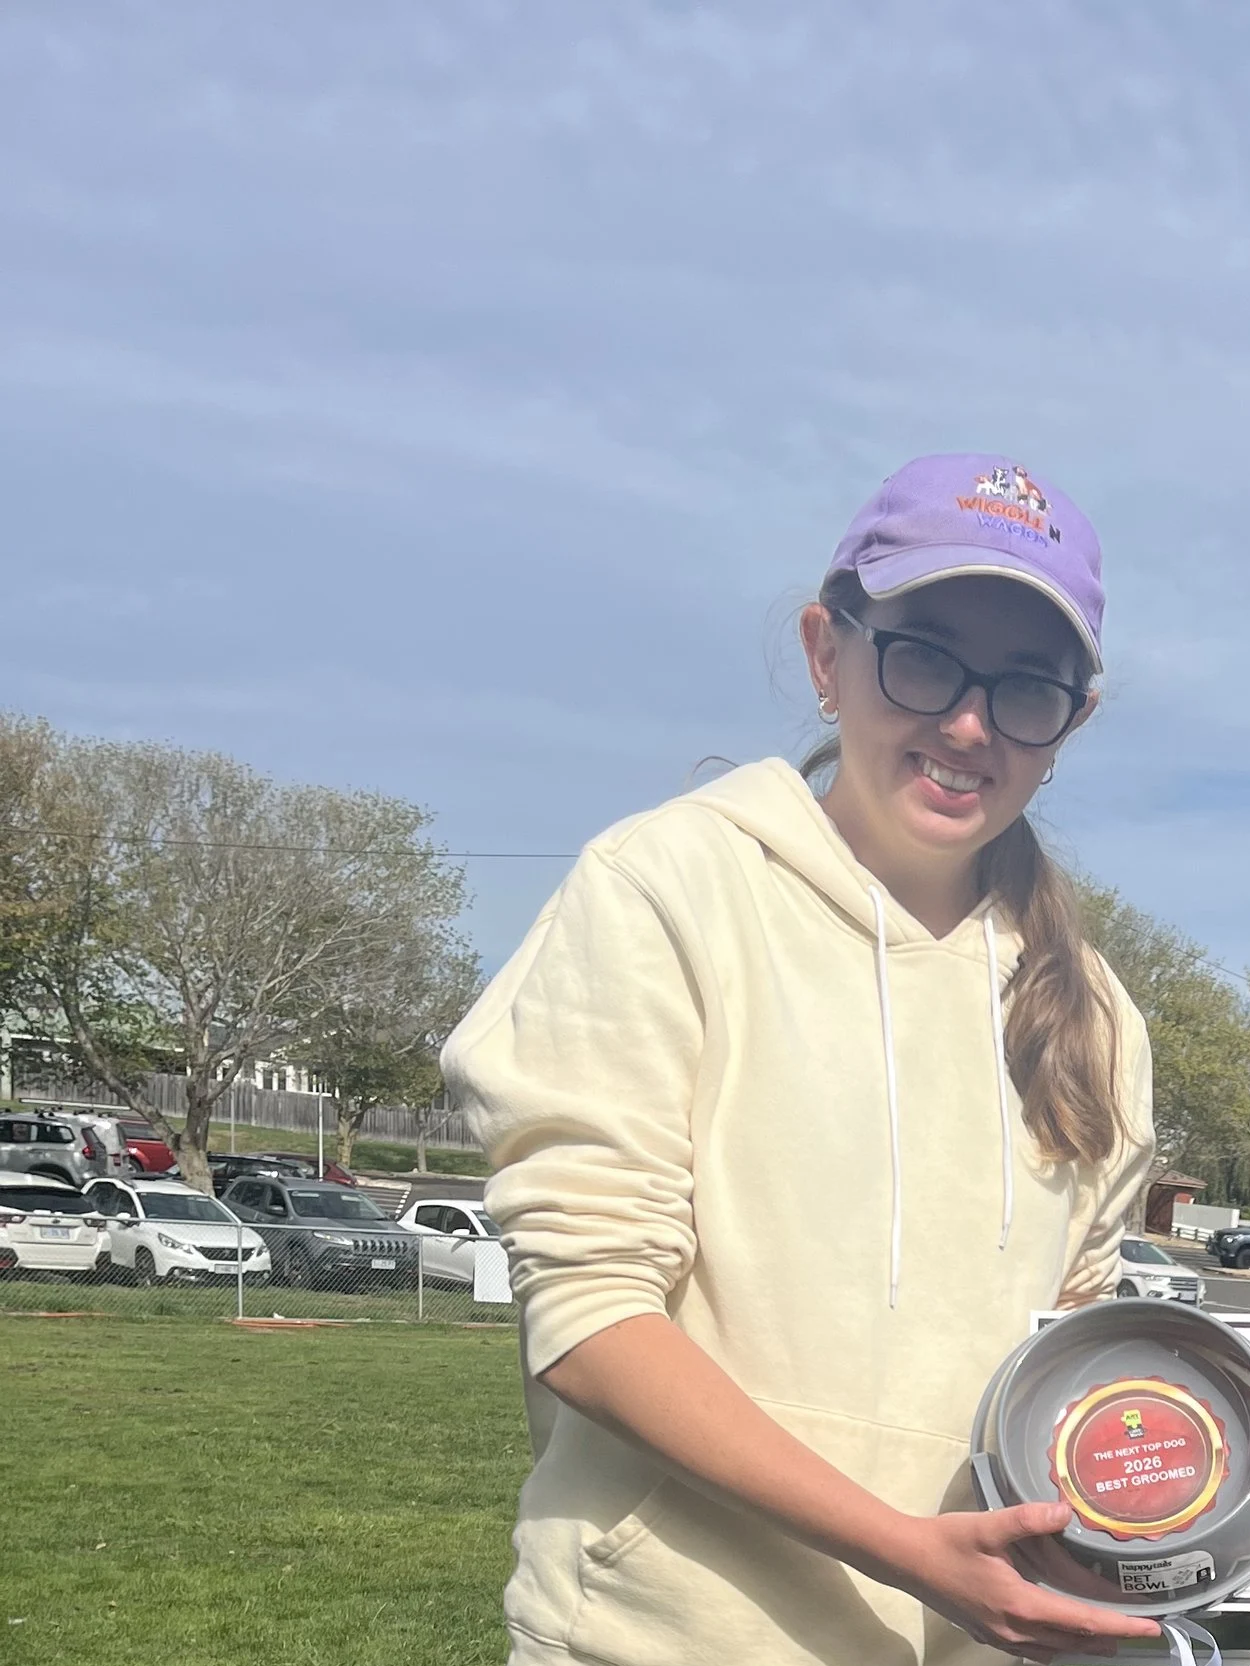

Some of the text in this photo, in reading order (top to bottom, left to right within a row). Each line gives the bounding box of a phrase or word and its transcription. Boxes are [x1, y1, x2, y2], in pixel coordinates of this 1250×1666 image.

[1093, 1438, 1187, 1462] THE NEXT TOP DOG
[1124, 1456, 1162, 1474] 2026
[1096, 1466, 1196, 1493] BEST GROOMED
[1123, 1574, 1152, 1583] PET
[1124, 1581, 1170, 1591] BOWL
